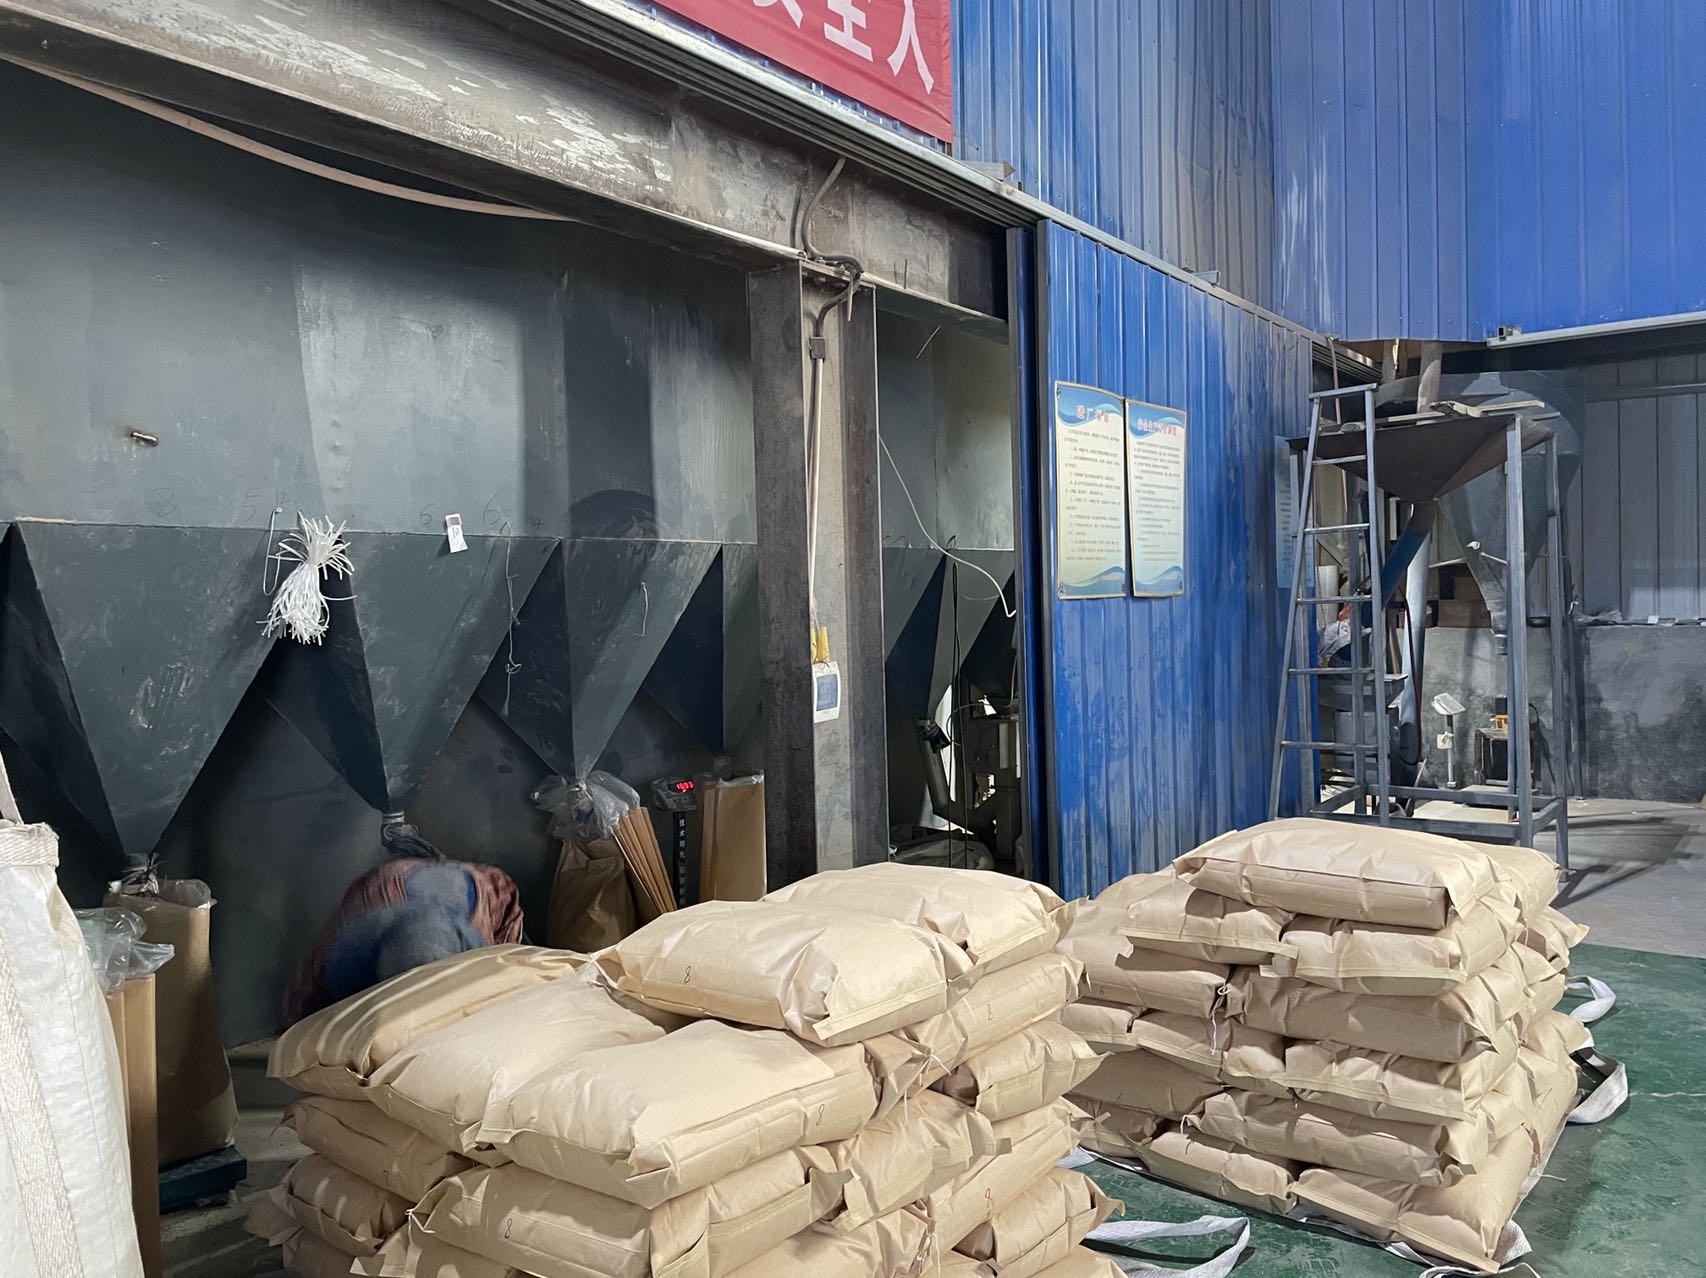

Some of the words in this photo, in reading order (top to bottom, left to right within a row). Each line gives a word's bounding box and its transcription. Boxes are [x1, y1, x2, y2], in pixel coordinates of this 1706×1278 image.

[482, 492, 501, 526] 6
[683, 965, 692, 985] 8
[986, 1003, 994, 1021] 8
[816, 1103, 825, 1126] 8
[503, 1218, 512, 1239] 8
